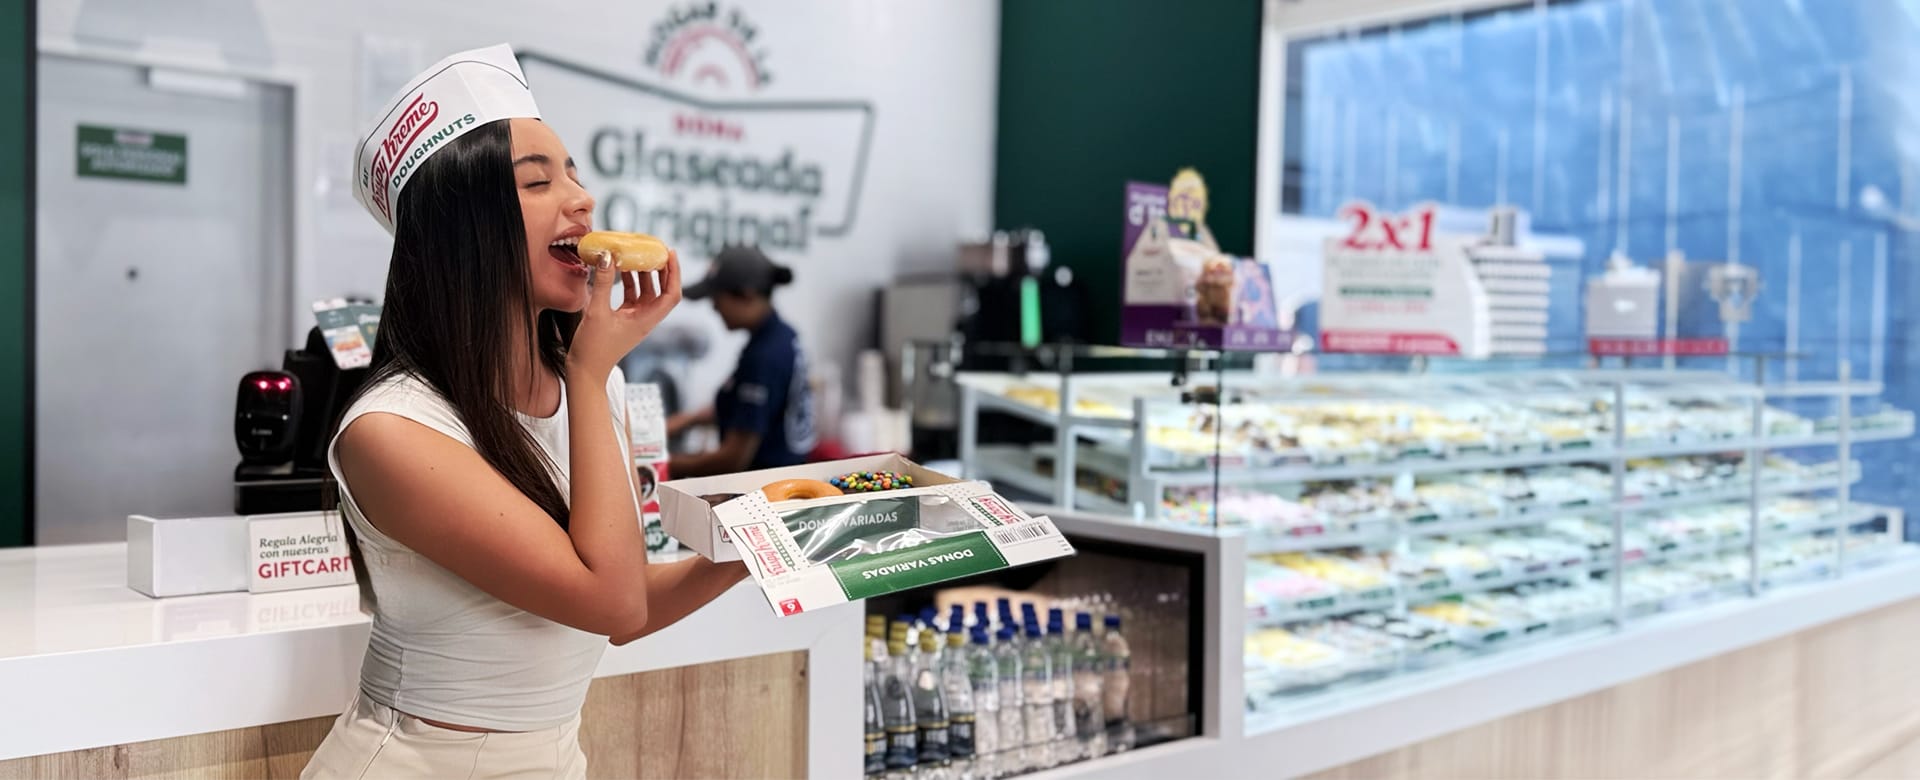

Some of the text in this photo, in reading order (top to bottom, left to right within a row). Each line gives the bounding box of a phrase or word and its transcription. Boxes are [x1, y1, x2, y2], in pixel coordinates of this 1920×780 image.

[381, 93, 438, 176] Kreme
[392, 113, 476, 188] DOUGHNUTS
[591, 129, 820, 196] Glaseada
[605, 192, 810, 258] Original
[1340, 206, 1436, 251] 2x1
[841, 511, 898, 527] VARIADAS
[260, 537, 296, 549] Regala
[260, 546, 329, 559] con nuestras
[862, 549, 974, 579] DONAS VARIADAS
